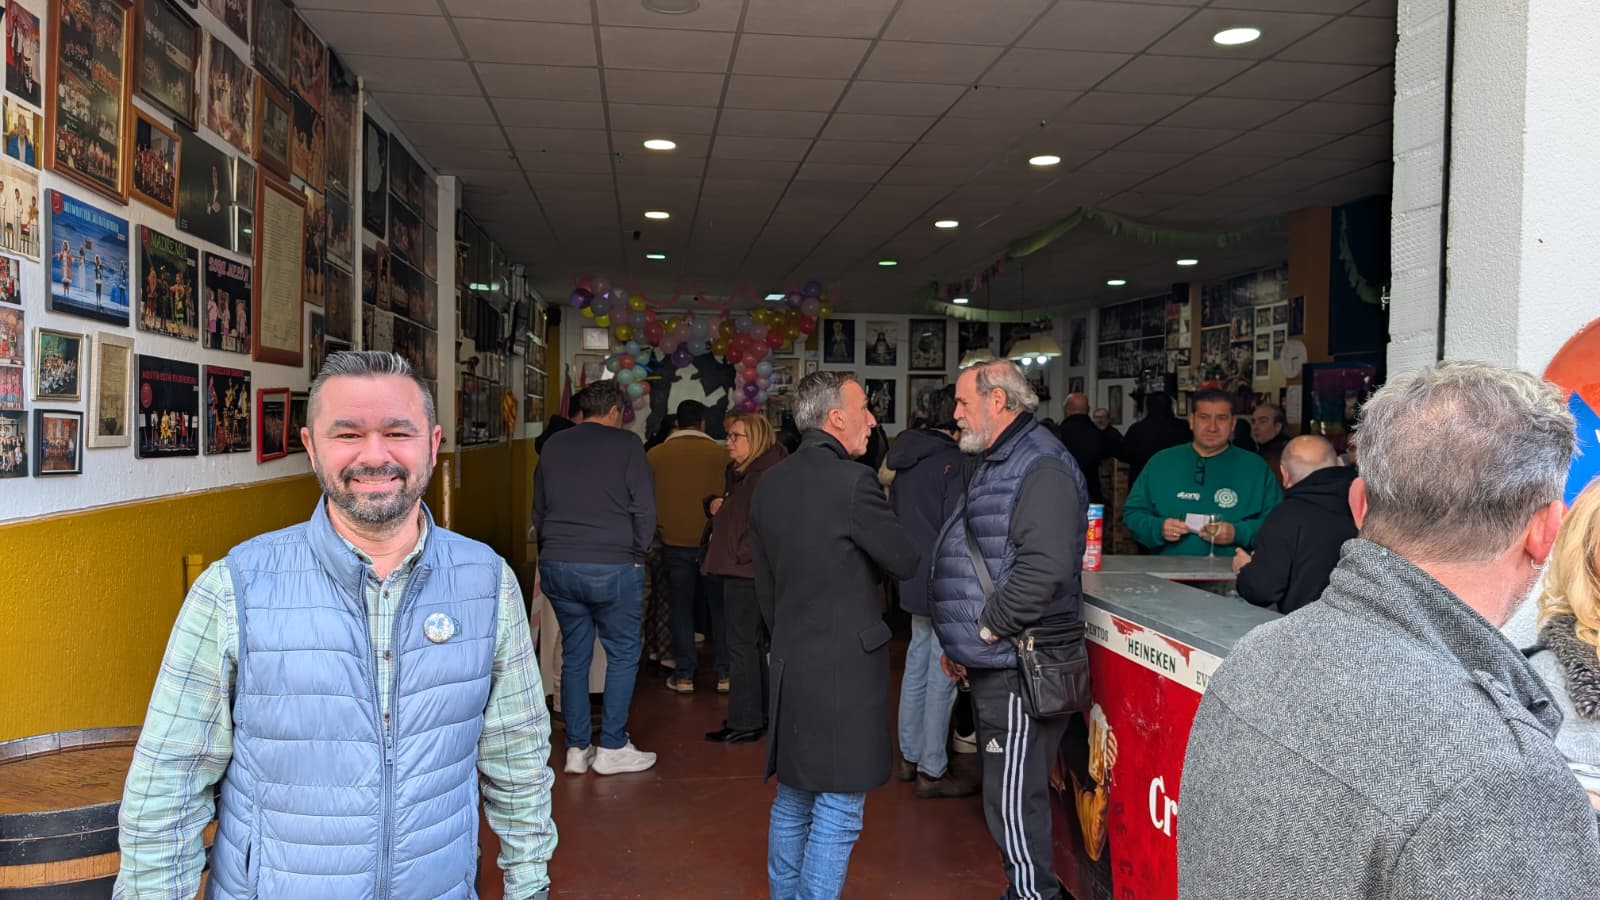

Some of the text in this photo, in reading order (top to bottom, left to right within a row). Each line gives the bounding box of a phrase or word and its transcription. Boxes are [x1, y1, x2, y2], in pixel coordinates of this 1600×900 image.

[1086, 621, 1211, 687] VENTOS HEINEKEN EV
[1149, 775, 1178, 837] Cr
